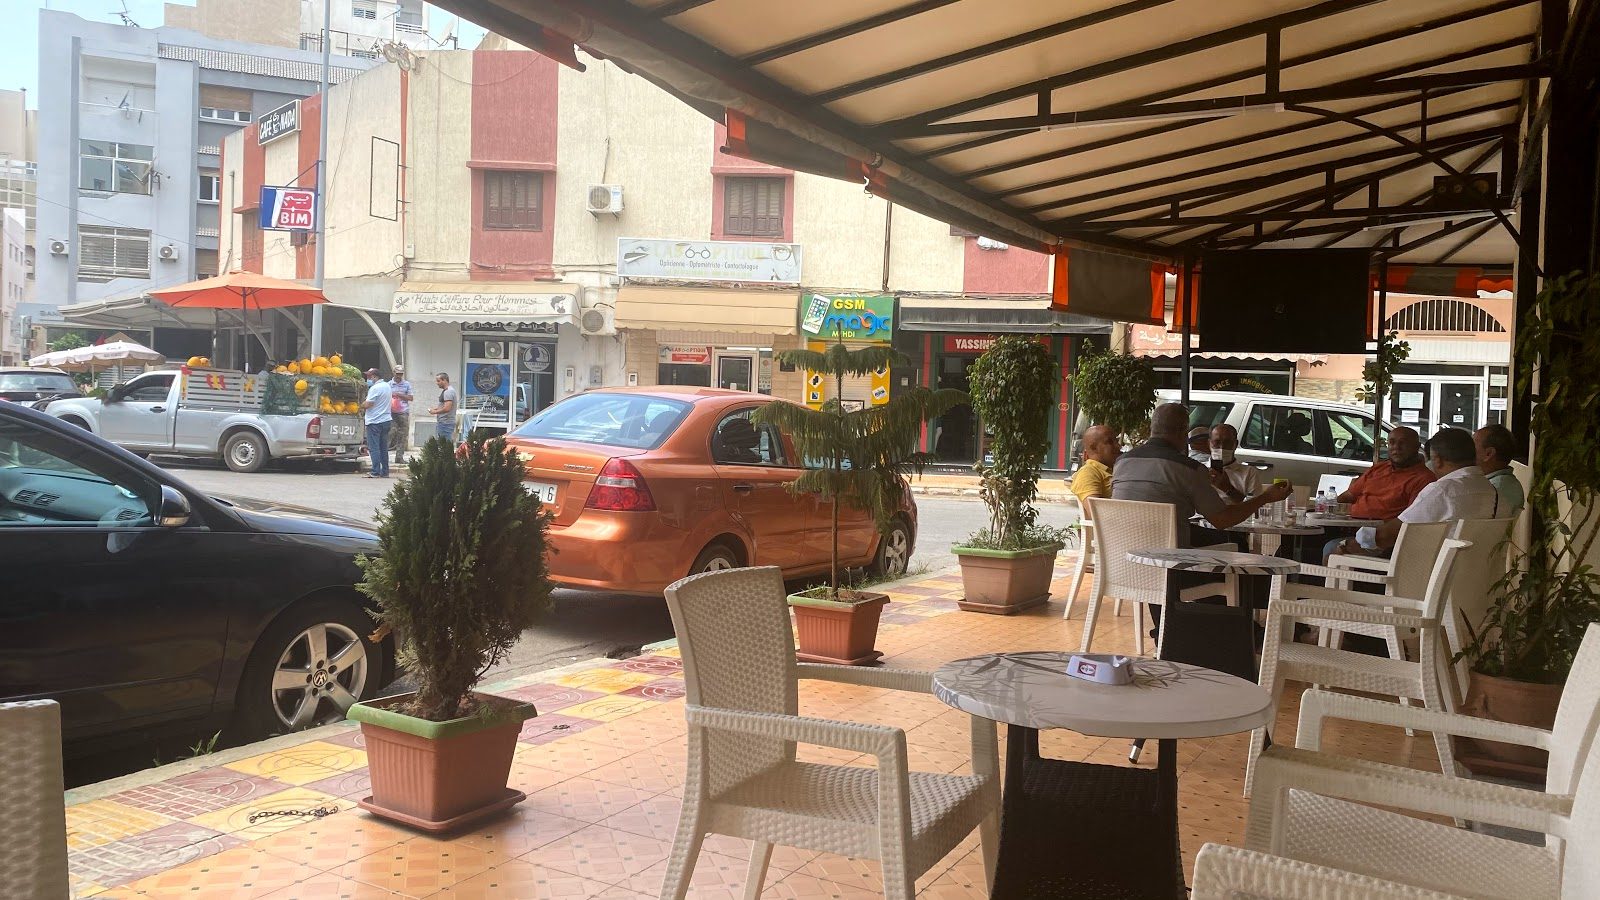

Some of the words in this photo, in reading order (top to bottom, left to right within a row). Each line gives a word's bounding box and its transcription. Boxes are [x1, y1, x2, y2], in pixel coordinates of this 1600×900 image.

[260, 115, 272, 139] CAFÉ
[280, 109, 295, 132] NADA
[280, 212, 308, 225] BIM
[473, 294, 493, 304] Pour
[833, 299, 865, 310] GSM
[329, 424, 356, 436] ISUZU
